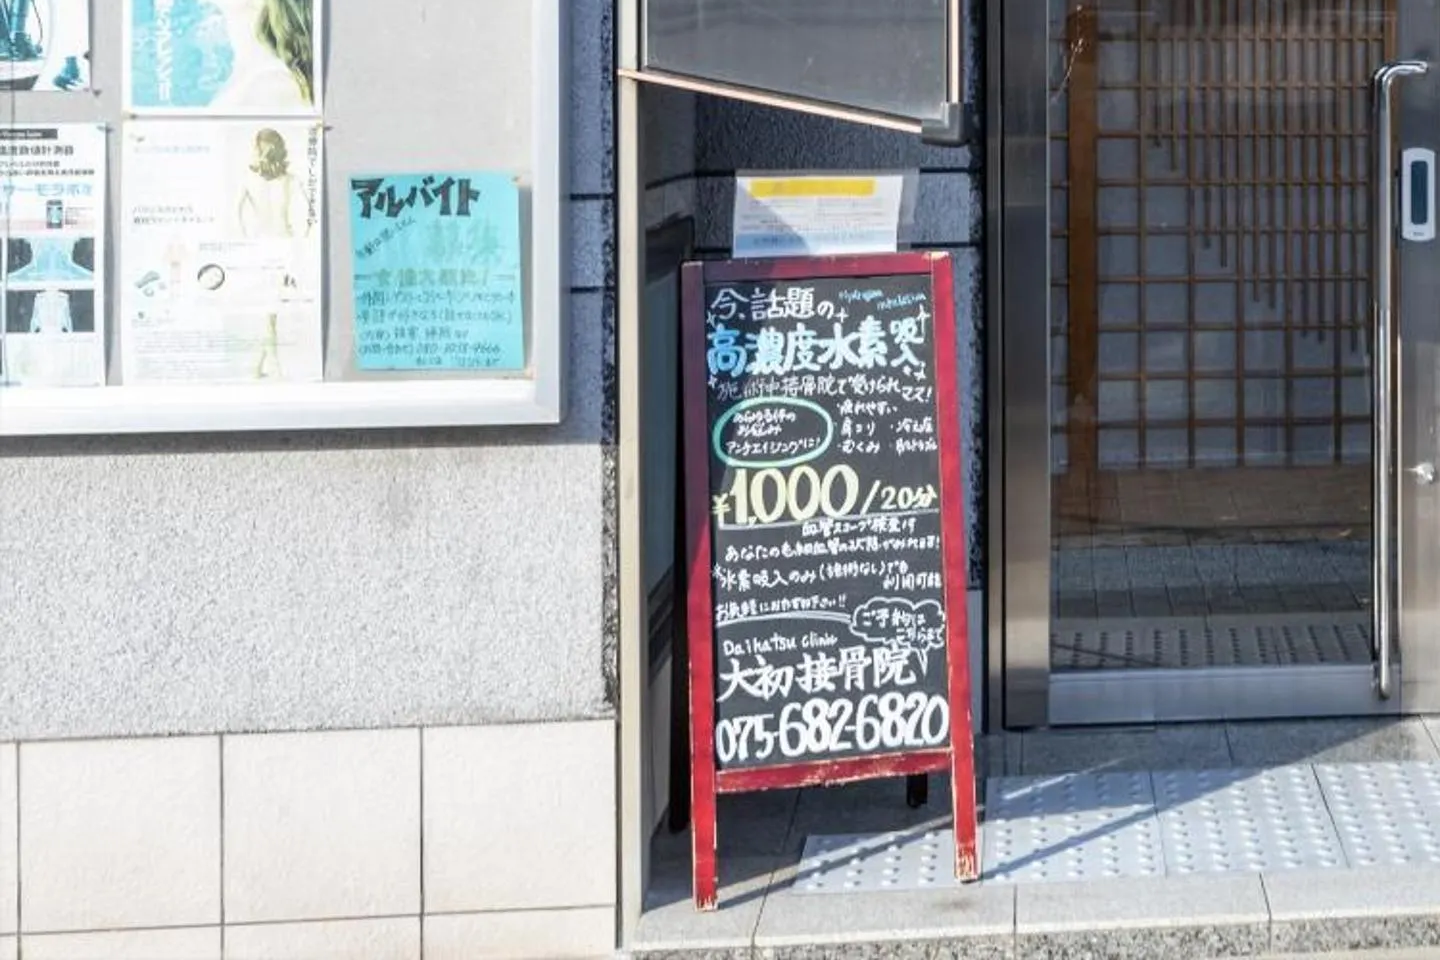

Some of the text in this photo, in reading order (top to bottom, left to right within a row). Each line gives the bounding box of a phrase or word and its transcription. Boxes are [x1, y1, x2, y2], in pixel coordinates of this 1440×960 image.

[350, 174, 481, 219] アルバイト
[710, 287, 835, 321] 今、話題の
[717, 644, 918, 702] 大初接骨院
[716, 691, 949, 762] 075-682-6820
